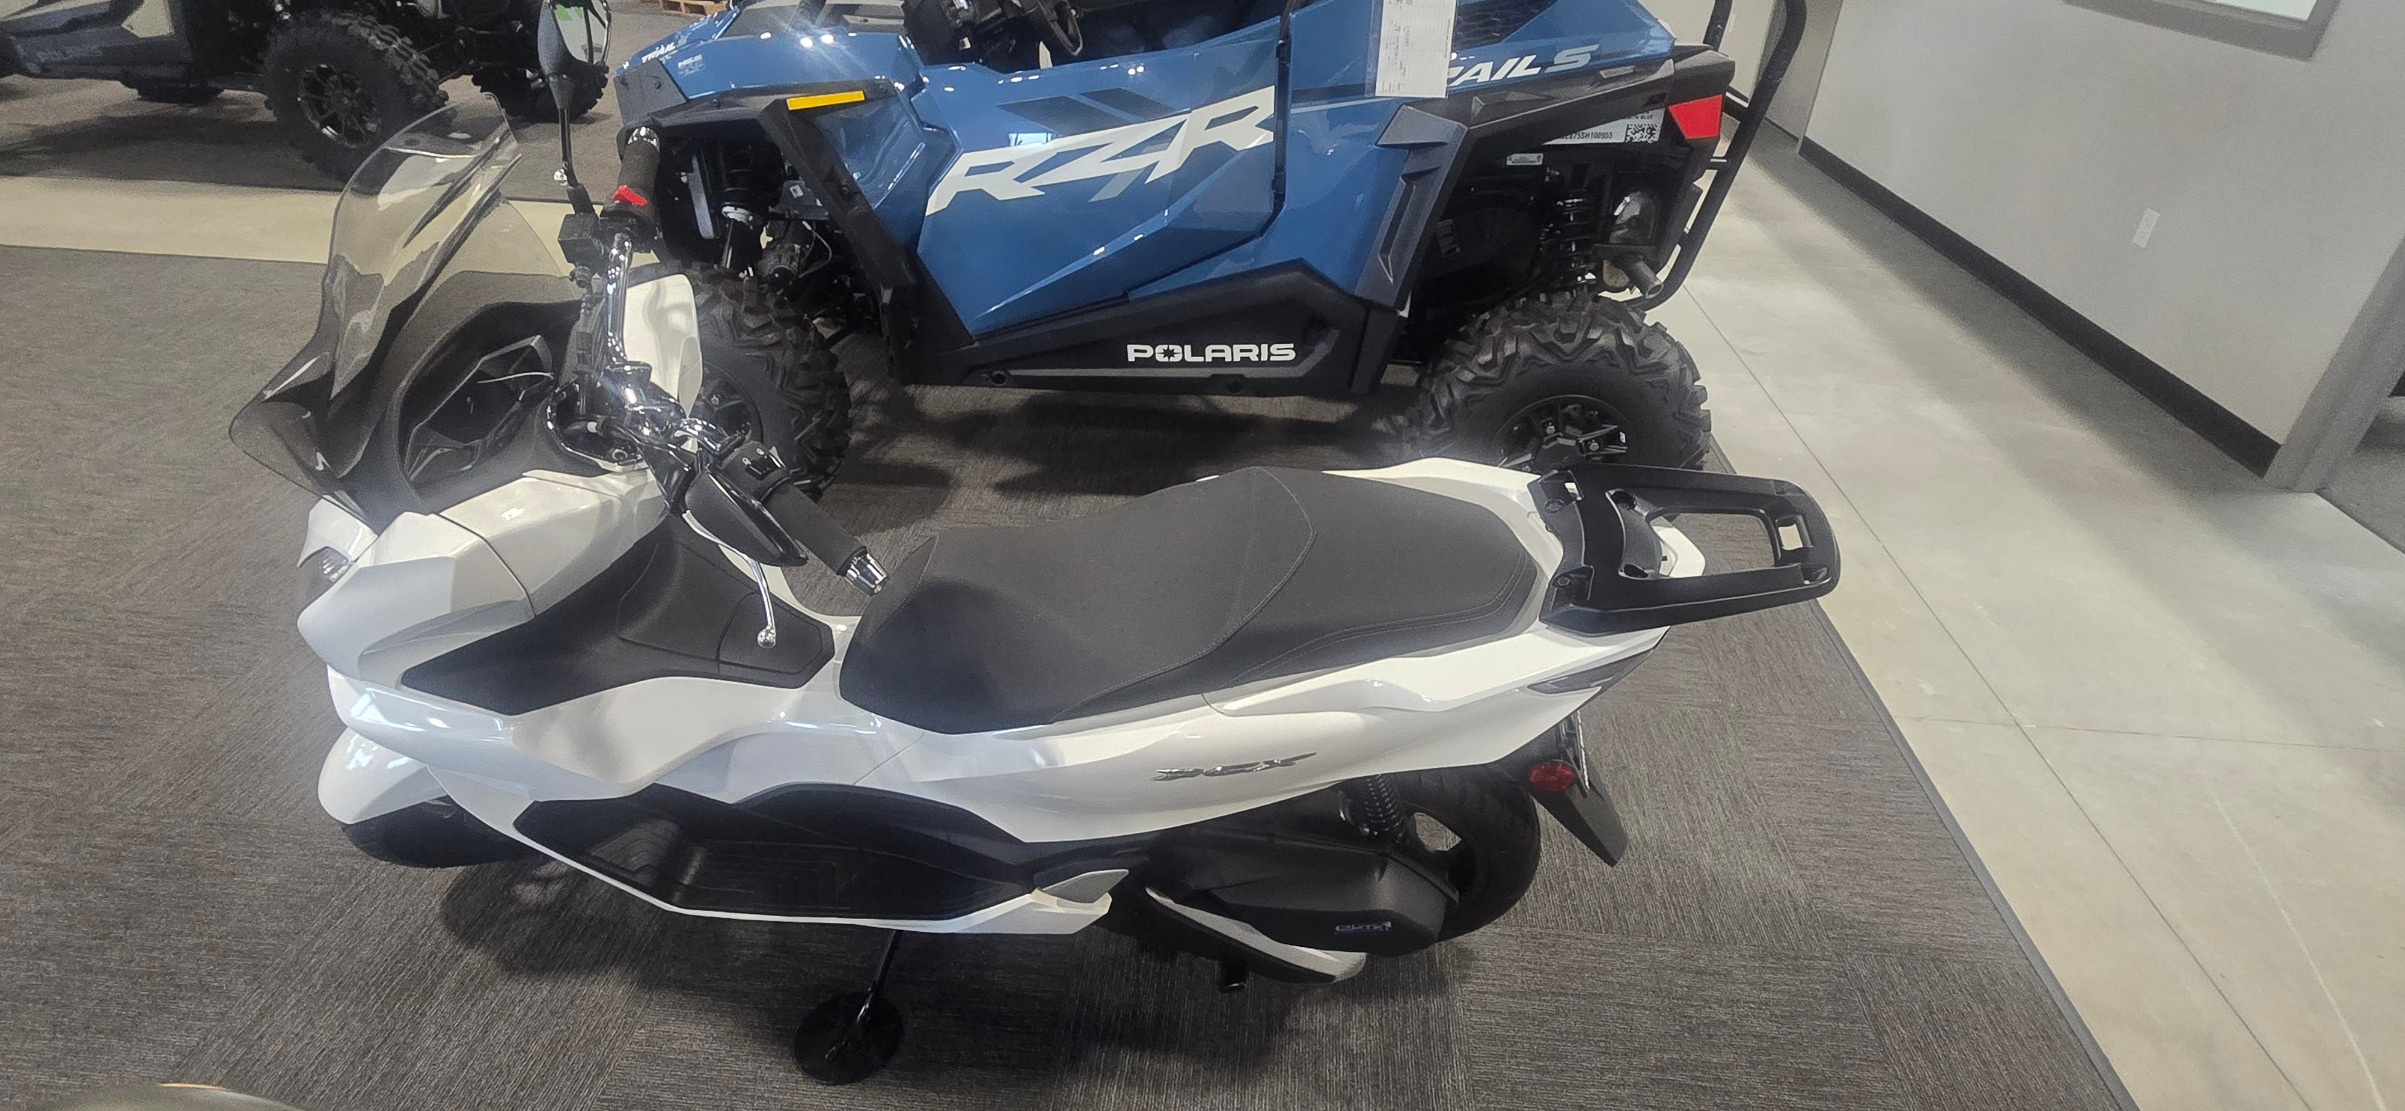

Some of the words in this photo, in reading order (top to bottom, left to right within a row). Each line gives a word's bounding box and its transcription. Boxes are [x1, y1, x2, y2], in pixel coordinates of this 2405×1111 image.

[1544, 44, 1599, 73] S
[925, 84, 1275, 217] RZR
[1127, 343, 1296, 362] POLARIS
